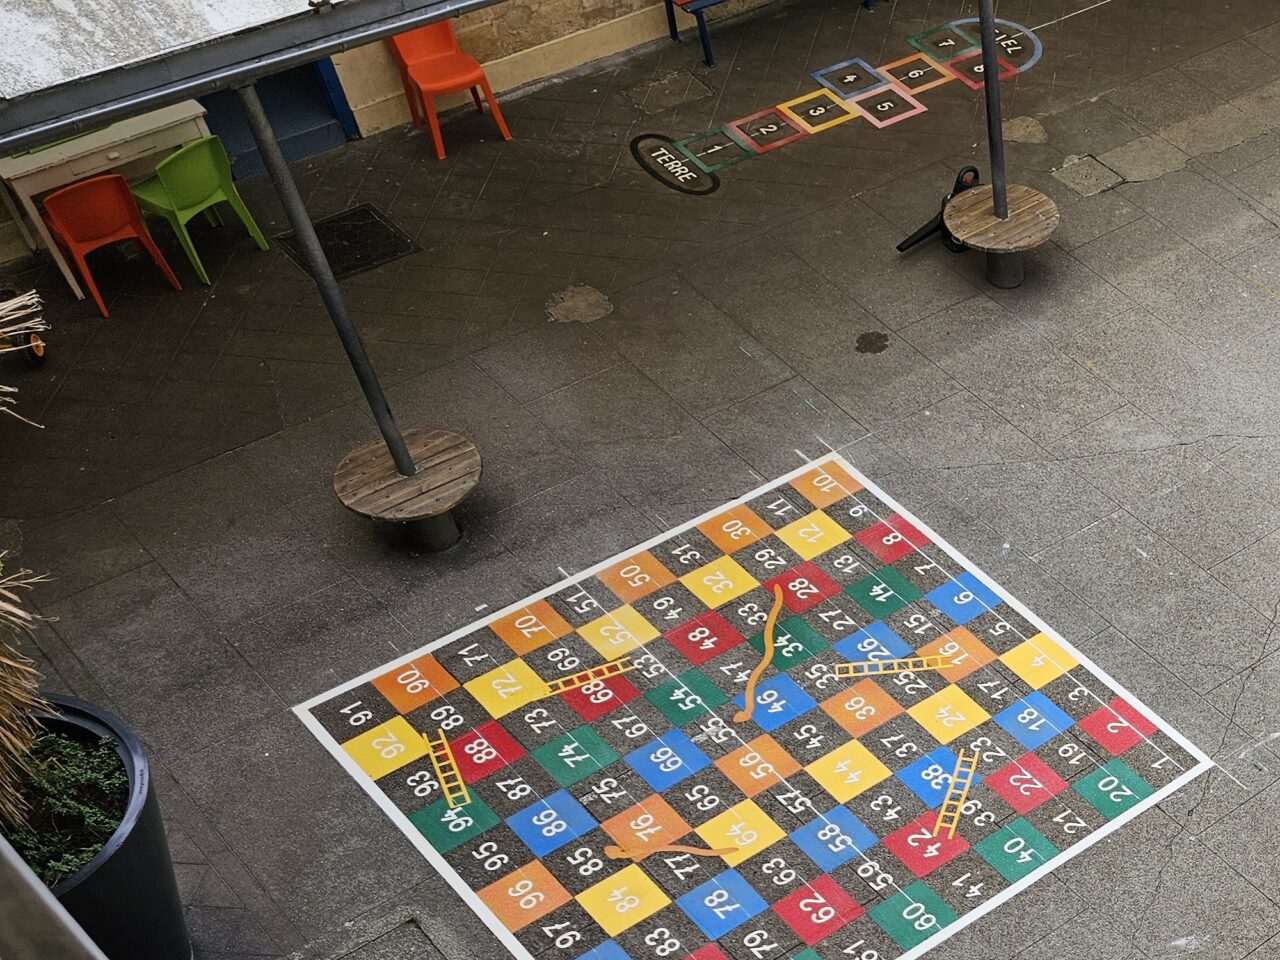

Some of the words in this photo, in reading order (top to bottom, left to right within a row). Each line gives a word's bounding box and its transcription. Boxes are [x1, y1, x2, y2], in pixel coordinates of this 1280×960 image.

[938, 38, 956, 47] 7
[995, 29, 1022, 54] IEL
[843, 74, 857, 83] 4
[908, 69, 924, 78] 6
[809, 106, 826, 116] 3
[876, 101, 894, 111] 5
[759, 124, 778, 135] 2
[651, 147, 698, 183] TERRE
[813, 472, 840, 492] 10
[766, 497, 796, 516] 11
[849, 502, 871, 517] 9
[722, 519, 752, 540] 30
[798, 523, 825, 543] 12
[882, 530, 906, 545] 8
[671, 543, 701, 564] 31
[754, 548, 787, 569] 29
[833, 555, 860, 573] 13
[620, 565, 651, 587] 50
[913, 558, 940, 576] 7
[702, 570, 734, 594] 32
[788, 578, 820, 599] 28
[869, 581, 899, 602] 14
[566, 589, 600, 614] 51
[653, 596, 683, 620] 49
[953, 588, 977, 605] 6
[514, 615, 548, 638] 70
[737, 603, 768, 626] 33
[817, 609, 857, 631] 27
[903, 614, 933, 635] 15
[989, 619, 1014, 636] 5
[599, 619, 635, 646] 52
[687, 627, 718, 650] 48
[773, 631, 804, 657] 34
[457, 642, 489, 667] 71
[547, 647, 580, 671] 69
[857, 636, 892, 662] 26
[939, 641, 969, 665] 16
[1030, 651, 1052, 667] 4
[633, 652, 669, 679] 53
[719, 661, 752, 683] 47
[804, 663, 839, 689] 35
[397, 667, 430, 694] 90
[490, 672, 524, 701] 72
[581, 677, 615, 704] 68
[892, 670, 929, 695] 25
[977, 680, 1009, 700] 17
[1068, 684, 1092, 701] 3
[669, 684, 704, 711] 54
[756, 689, 787, 713] 46
[844, 696, 876, 720] 36
[339, 700, 373, 726] 91
[430, 705, 464, 731] 89
[524, 708, 557, 734] 73
[935, 705, 966, 727] 24
[1017, 706, 1047, 731] 18
[1106, 715, 1131, 734] 2
[611, 715, 653, 738] 67
[699, 715, 737, 744] 55
[792, 724, 824, 749] 45
[370, 731, 406, 759] 92
[464, 738, 499, 764] 88
[558, 739, 591, 768] 74
[879, 734, 917, 758] 37
[969, 736, 1006, 763] 23
[1058, 743, 1088, 765] 19
[650, 746, 683, 772] 66
[739, 752, 775, 780] 56
[832, 759, 863, 785] 44
[1151, 754, 1174, 769] 1
[406, 770, 440, 797] 93
[495, 776, 537, 800] 87
[920, 763, 953, 790] 38
[1009, 768, 1044, 796] 22
[1097, 775, 1134, 802] 20
[591, 777, 628, 804] 75
[684, 784, 720, 811] 65
[775, 786, 812, 814] 57
[440, 806, 474, 832] 94
[870, 795, 902, 821] 43
[960, 799, 996, 827] 39
[1052, 807, 1088, 834] 21
[532, 809, 567, 837] 86
[630, 813, 662, 842] 76
[725, 821, 758, 846] 64
[817, 823, 853, 852] 58
[907, 827, 942, 858] 42
[1003, 836, 1037, 864] 40
[471, 841, 509, 871] 95
[566, 847, 604, 876] 85
[663, 853, 701, 881] 77
[761, 857, 797, 886] 63
[857, 859, 894, 891] 59
[508, 879, 545, 909] 96
[951, 872, 984, 898] 41
[607, 886, 640, 913] 84
[703, 889, 741, 920] 78
[799, 892, 836, 924] 62
[902, 901, 937, 931] 60
[541, 921, 582, 949] 97
[644, 927, 681, 957] 83
[743, 929, 779, 959] 79
